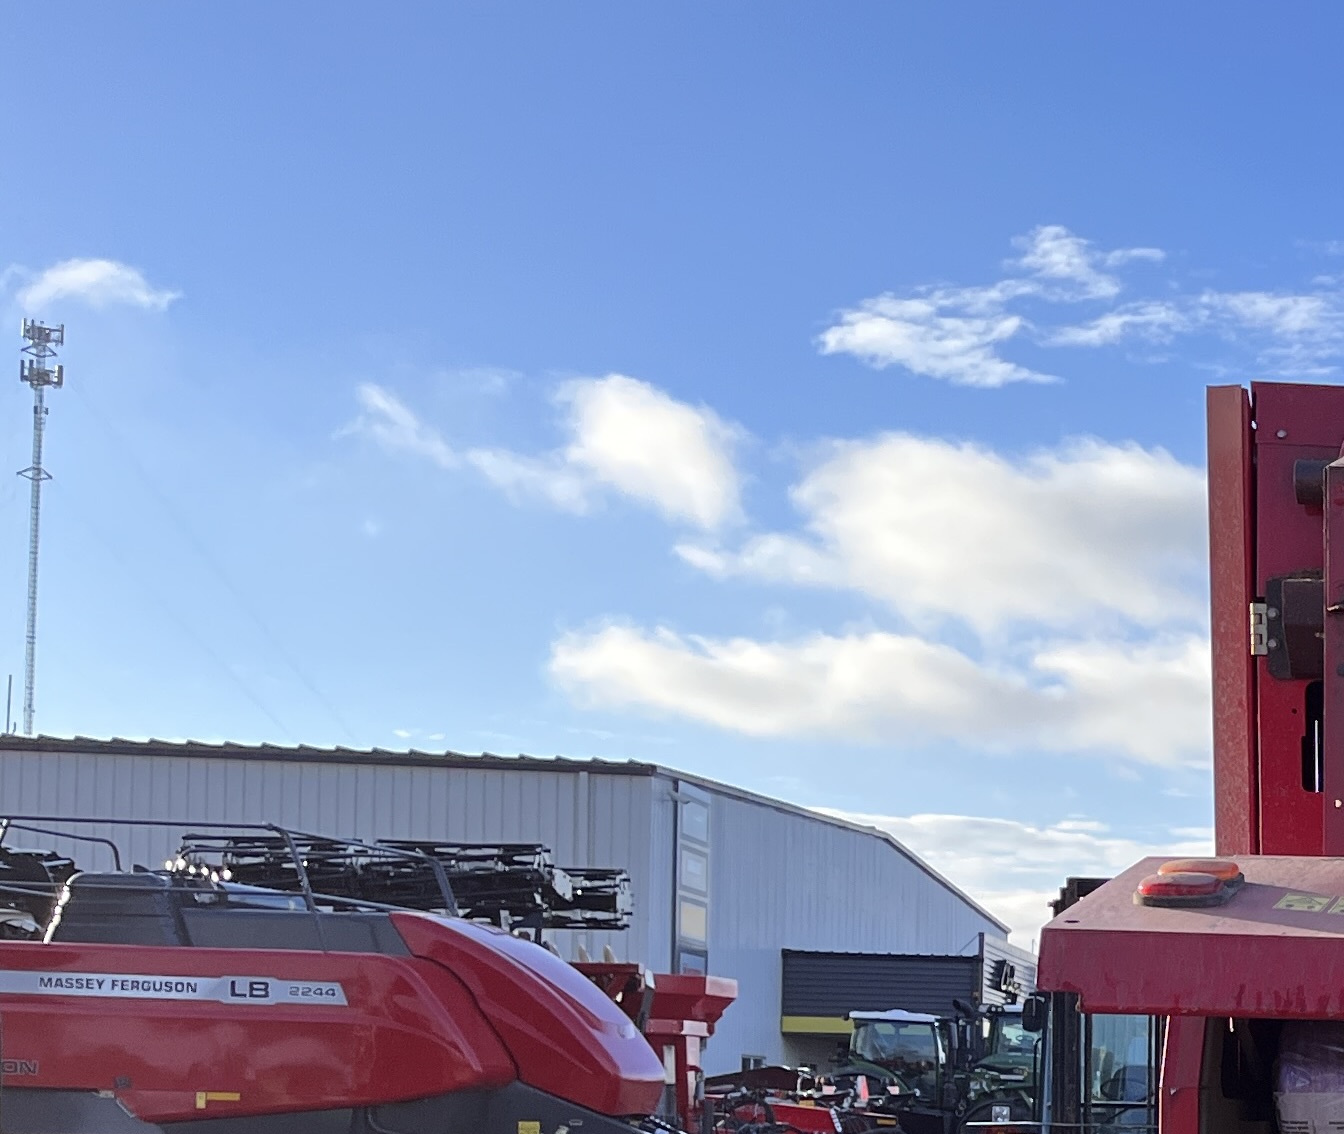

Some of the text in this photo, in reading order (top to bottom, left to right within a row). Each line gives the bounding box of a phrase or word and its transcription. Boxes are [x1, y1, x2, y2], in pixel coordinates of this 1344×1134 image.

[38, 976, 198, 993] MASSEY FERGUSON
[230, 980, 270, 998] LB
[288, 985, 336, 997] 2244
